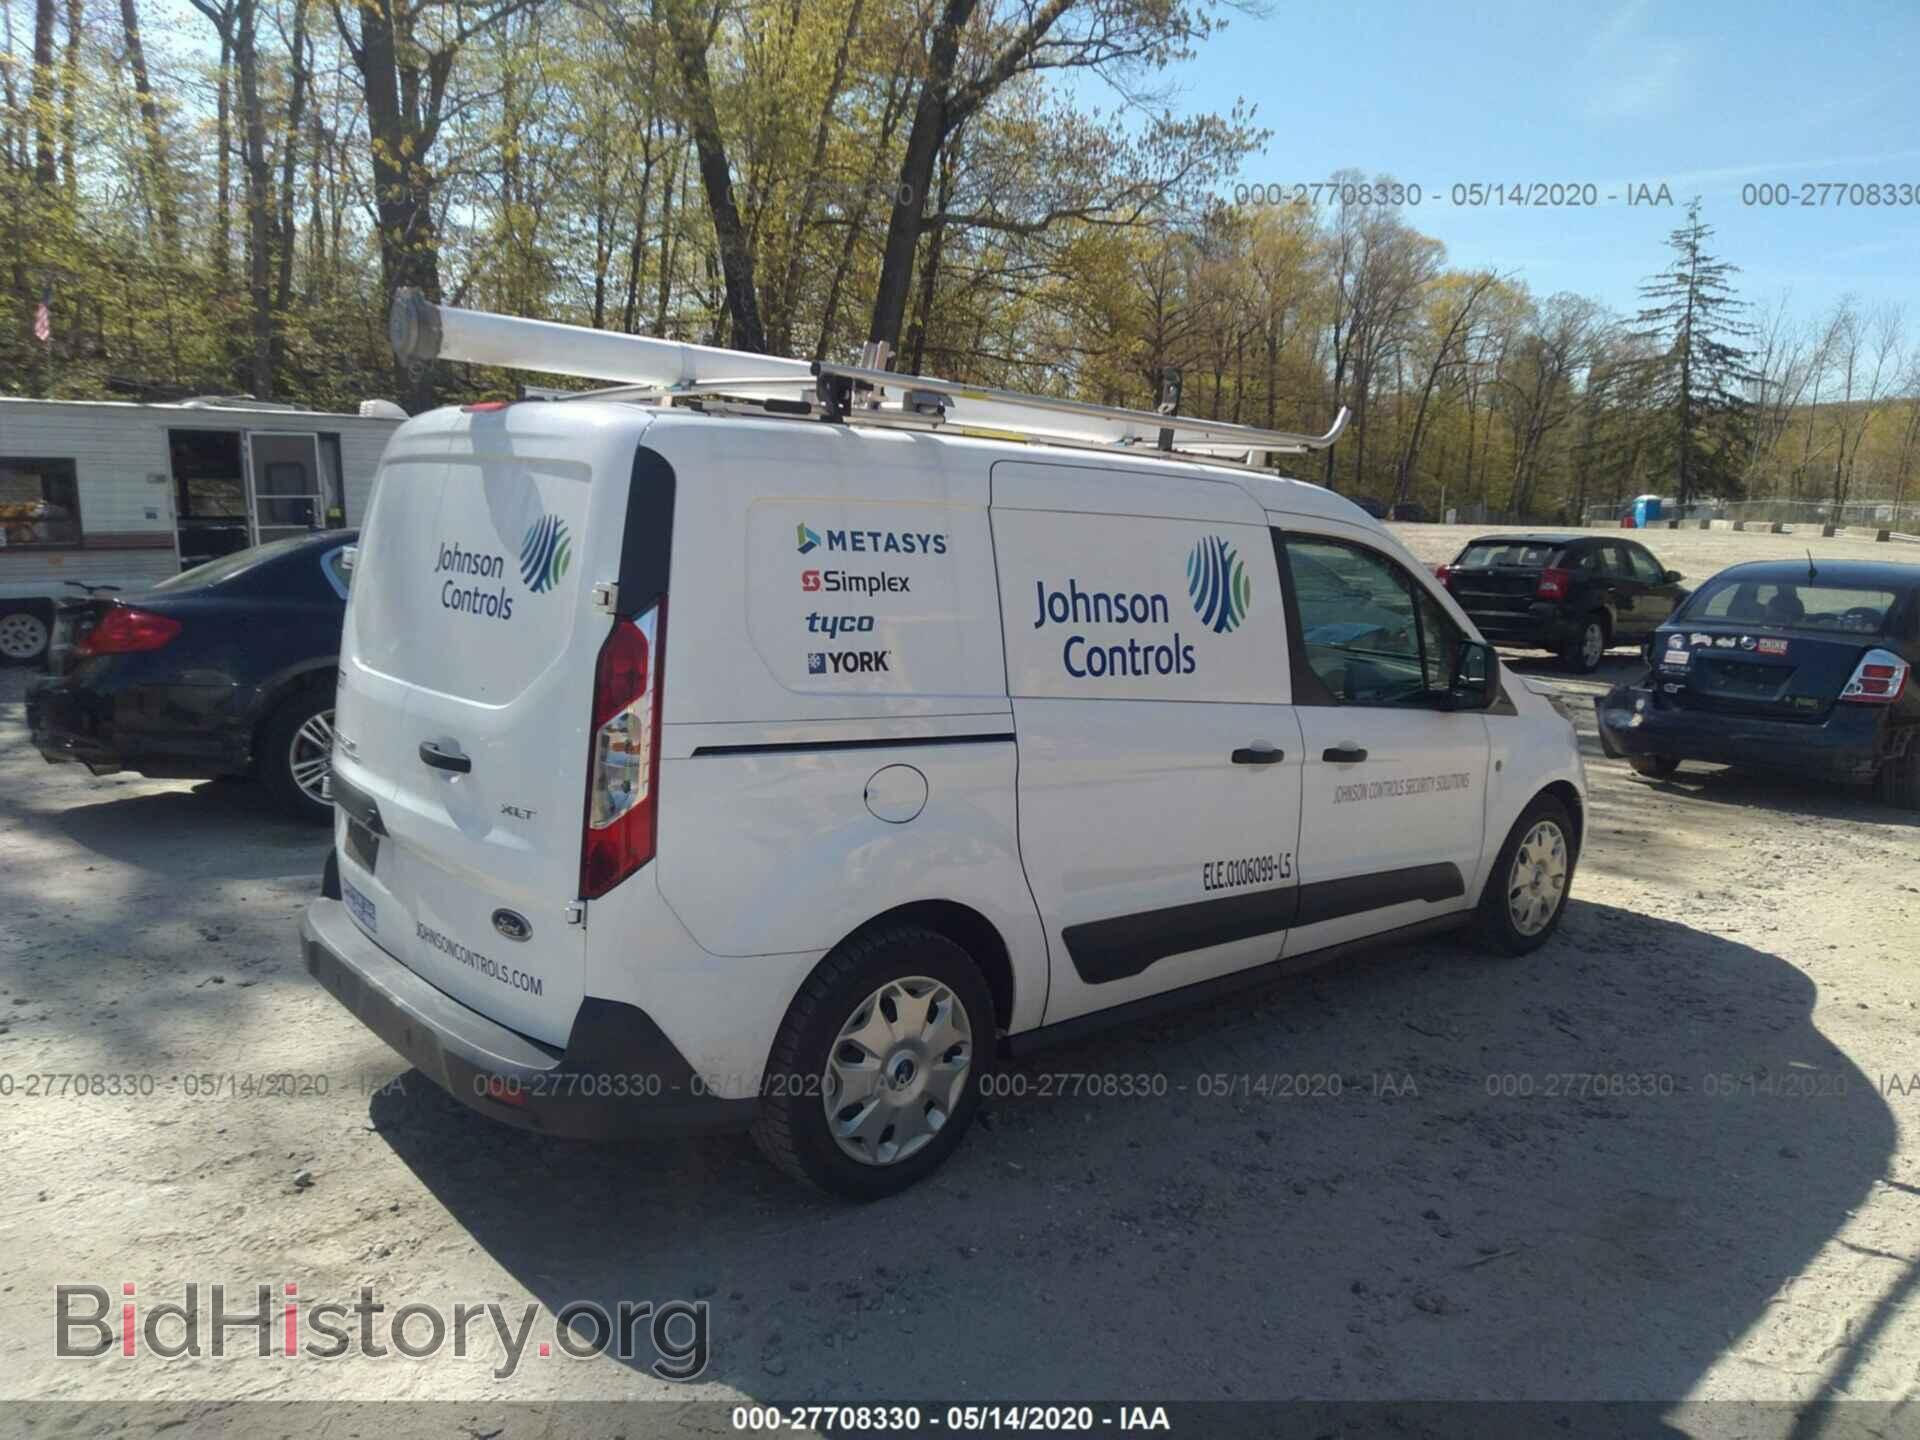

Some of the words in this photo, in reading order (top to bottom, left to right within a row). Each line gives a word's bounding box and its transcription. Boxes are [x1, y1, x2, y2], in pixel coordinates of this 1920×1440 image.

[826, 530, 947, 554] METASYS
[434, 542, 504, 579] Johnson
[823, 570, 911, 597] Simplex
[441, 579, 513, 621] Controls
[1034, 578, 1169, 629] Johnson
[805, 612, 875, 639] tyco
[828, 650, 889, 674] YORK
[1063, 632, 1197, 678] Controls
[501, 803, 538, 821] XLT
[416, 920, 544, 997] JOHNSONCONTROLS.COM
